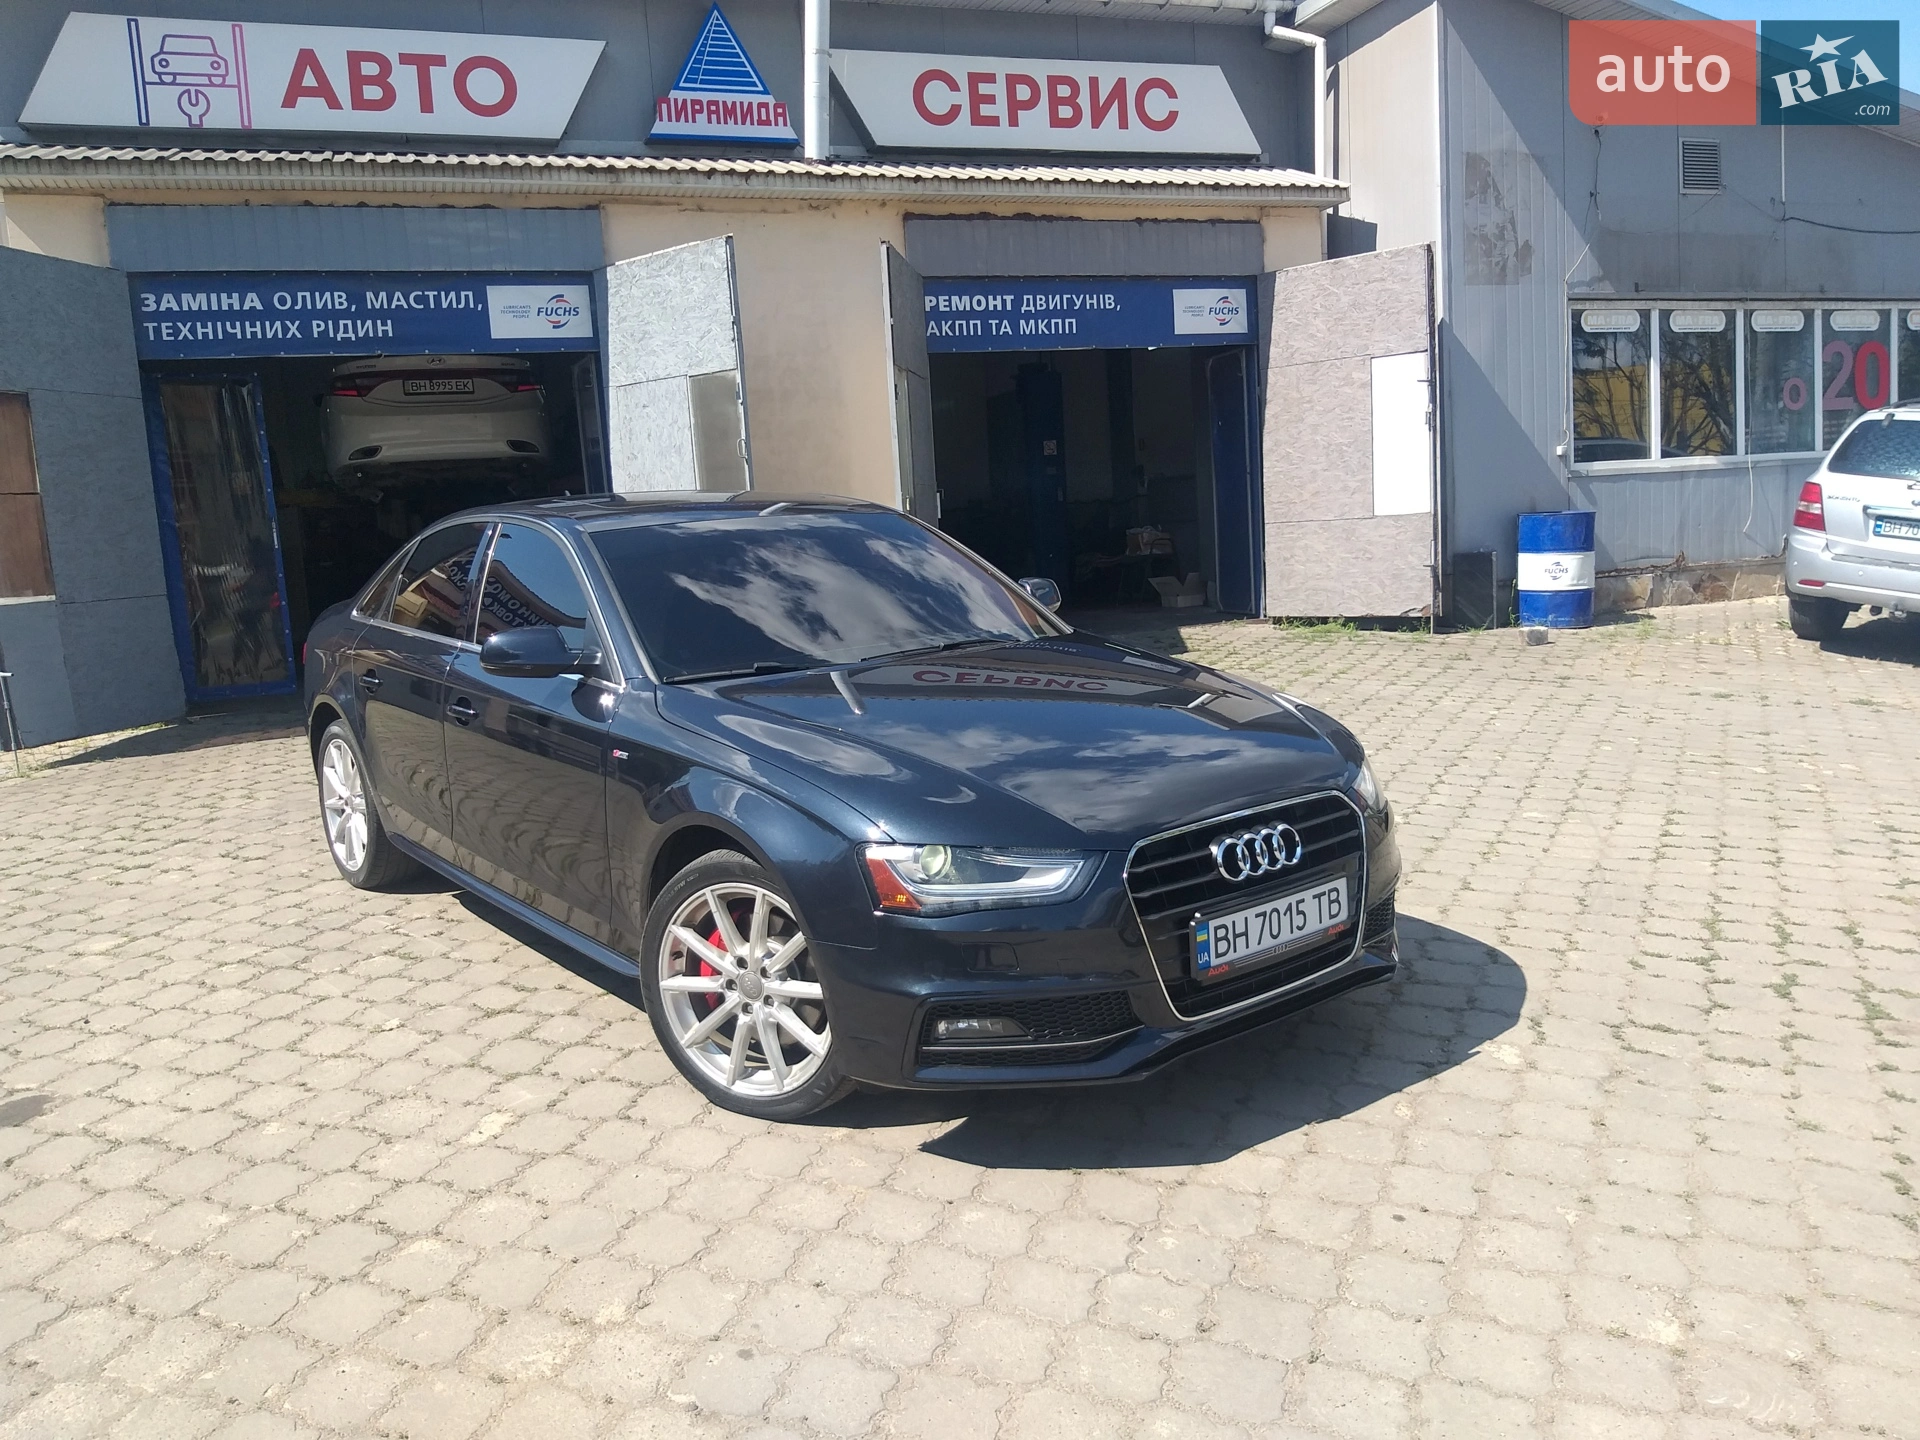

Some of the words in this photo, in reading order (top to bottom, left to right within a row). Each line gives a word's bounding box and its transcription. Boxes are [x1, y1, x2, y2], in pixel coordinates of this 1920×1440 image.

[280, 48, 518, 118] АВТО
[911, 68, 1180, 133] СЕРВИС
[657, 97, 789, 127] ПИРАМИДА
[140, 292, 264, 311] ЗАМІНА
[273, 291, 356, 311] ОЛИВ,
[366, 291, 483, 311] МАСТИЛ,
[924, 295, 1015, 311] РЕМОНТ
[1020, 294, 1121, 313] ДВИГУНІВ,
[536, 306, 580, 316] FUCHS
[1208, 306, 1240, 316] FUCHS
[143, 320, 302, 341] ТЕХНІЧНИХ
[311, 320, 393, 341] РІДИН
[926, 320, 982, 336] АКПП
[988, 320, 1013, 335] ТА
[1019, 319, 1077, 335] МКПП
[1822, 340, 1890, 410] 20
[410, 382, 427, 391] BH
[429, 381, 453, 391] 8995
[455, 381, 471, 390] EK
[1883, 521, 1903, 534] BH
[1214, 916, 1250, 959] BH
[1254, 898, 1307, 945] 7015
[1312, 887, 1342, 924] TB
[1327, 923, 1344, 935] Audi
[1197, 951, 1209, 964] UA
[1208, 964, 1229, 976] Audi
